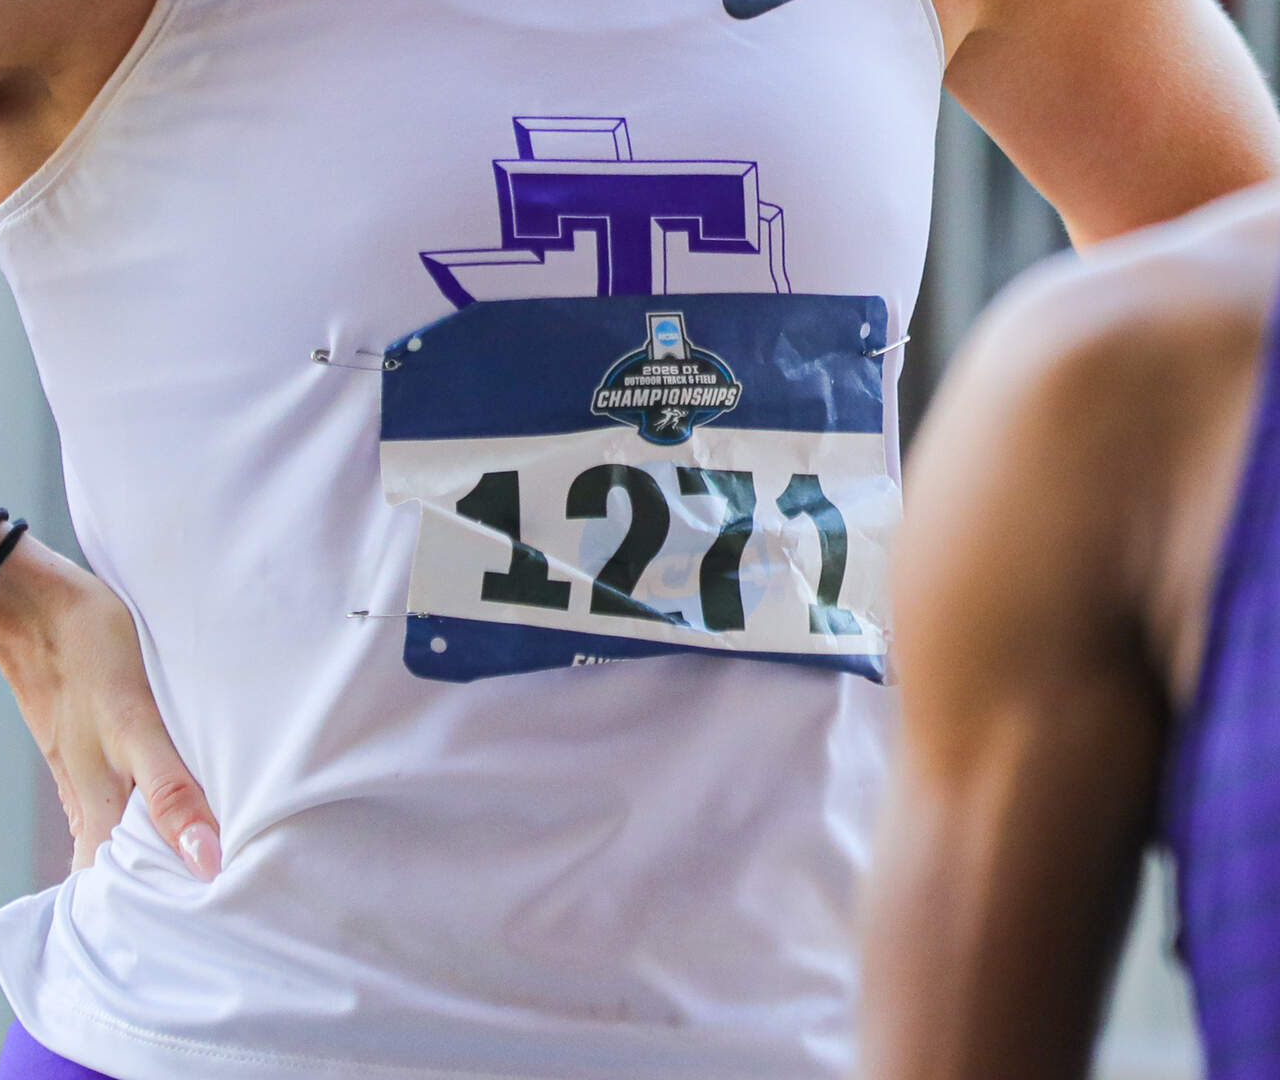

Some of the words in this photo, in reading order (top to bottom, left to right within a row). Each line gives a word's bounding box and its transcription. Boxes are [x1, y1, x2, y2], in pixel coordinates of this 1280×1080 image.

[642, 365, 680, 376] 2026
[624, 376, 661, 387] OUTDOOR
[663, 375, 688, 386] TRACK
[688, 375, 695, 385] &
[696, 374, 717, 385] FIELD
[596, 387, 738, 408] CHAMPIONSHIPS
[455, 463, 863, 635] 1271
